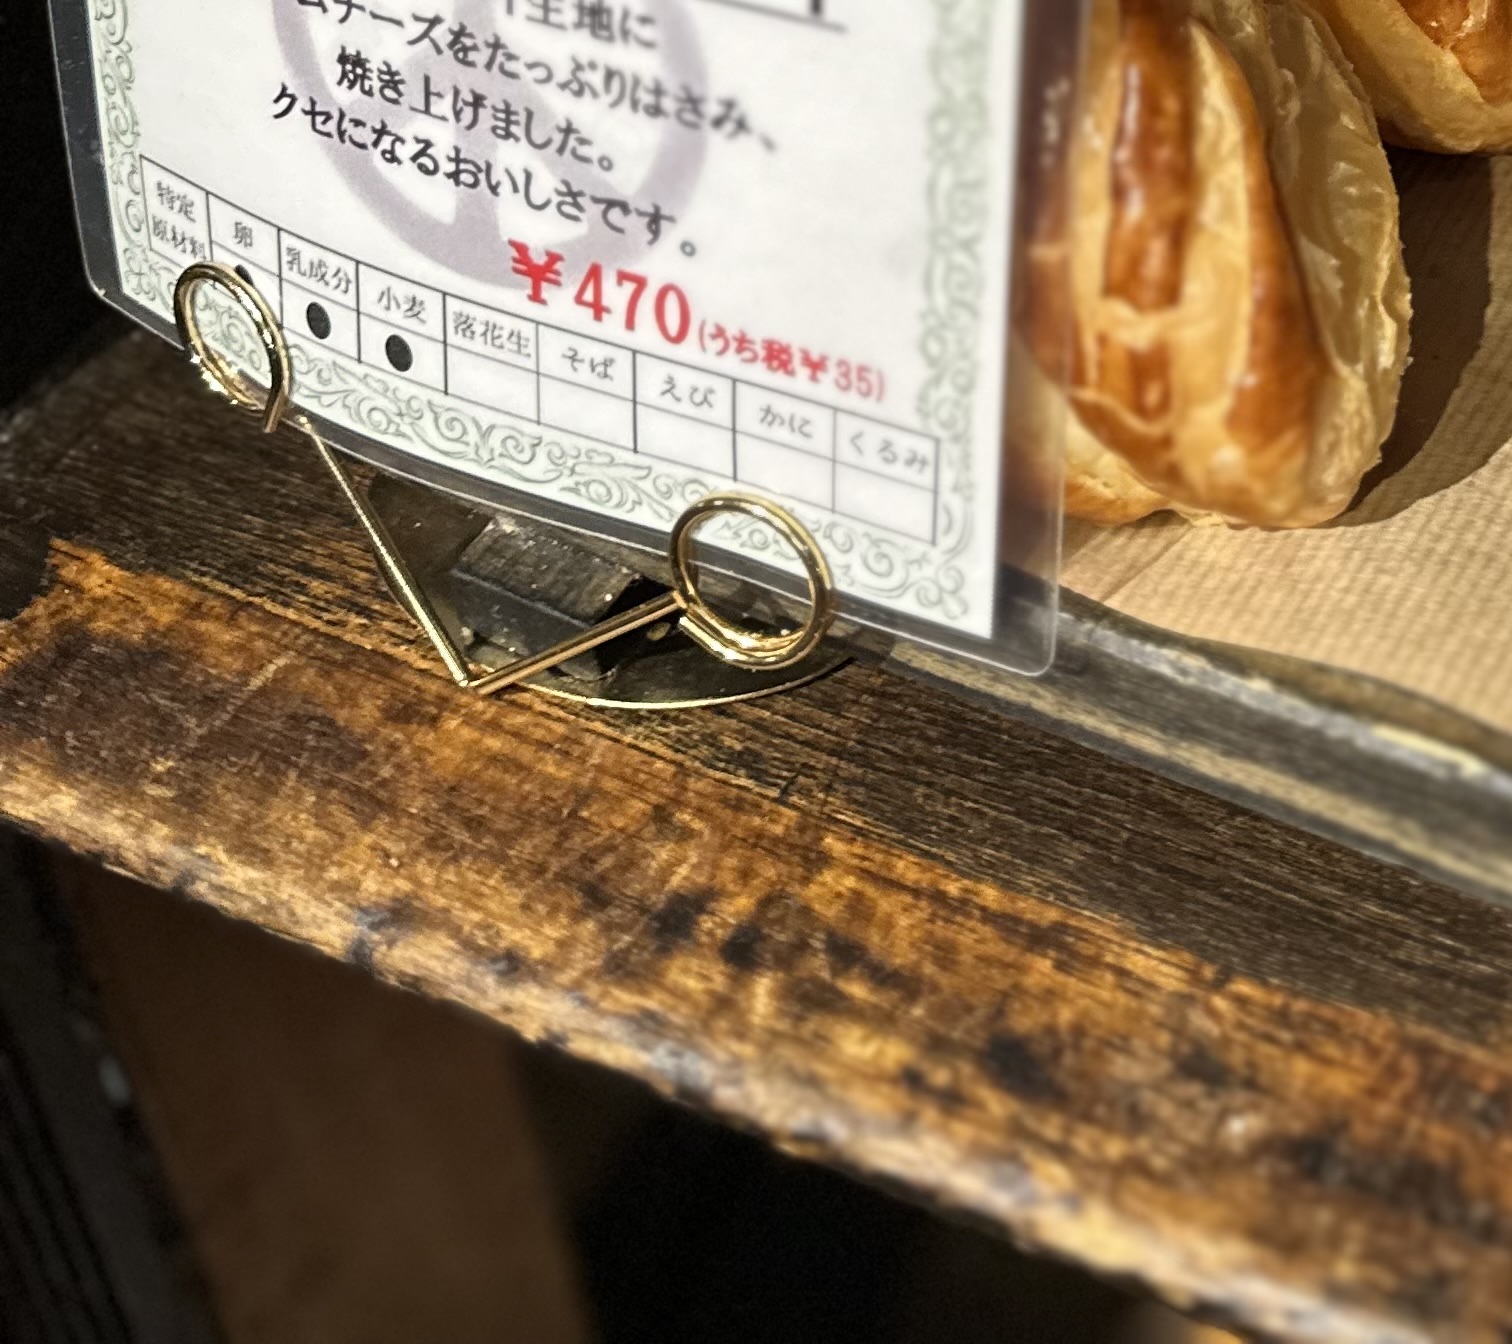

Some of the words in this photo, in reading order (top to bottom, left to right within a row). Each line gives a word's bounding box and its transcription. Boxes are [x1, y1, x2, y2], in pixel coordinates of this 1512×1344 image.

[336, 45, 614, 171] 焼き上げました。
[273, 82, 696, 258] クセになるおいしさです。
[156, 181, 196, 223] 特定
[152, 214, 207, 260] 原材料
[234, 221, 253, 248] 卵
[286, 246, 351, 294] 乳成分
[377, 286, 427, 324] 小麦
[508, 239, 691, 344] ¥470
[453, 310, 531, 358] 落花生
[562, 347, 616, 381] そば
[660, 375, 716, 408] えび
[759, 405, 813, 438] かに
[850, 432, 929, 472] くるみ
